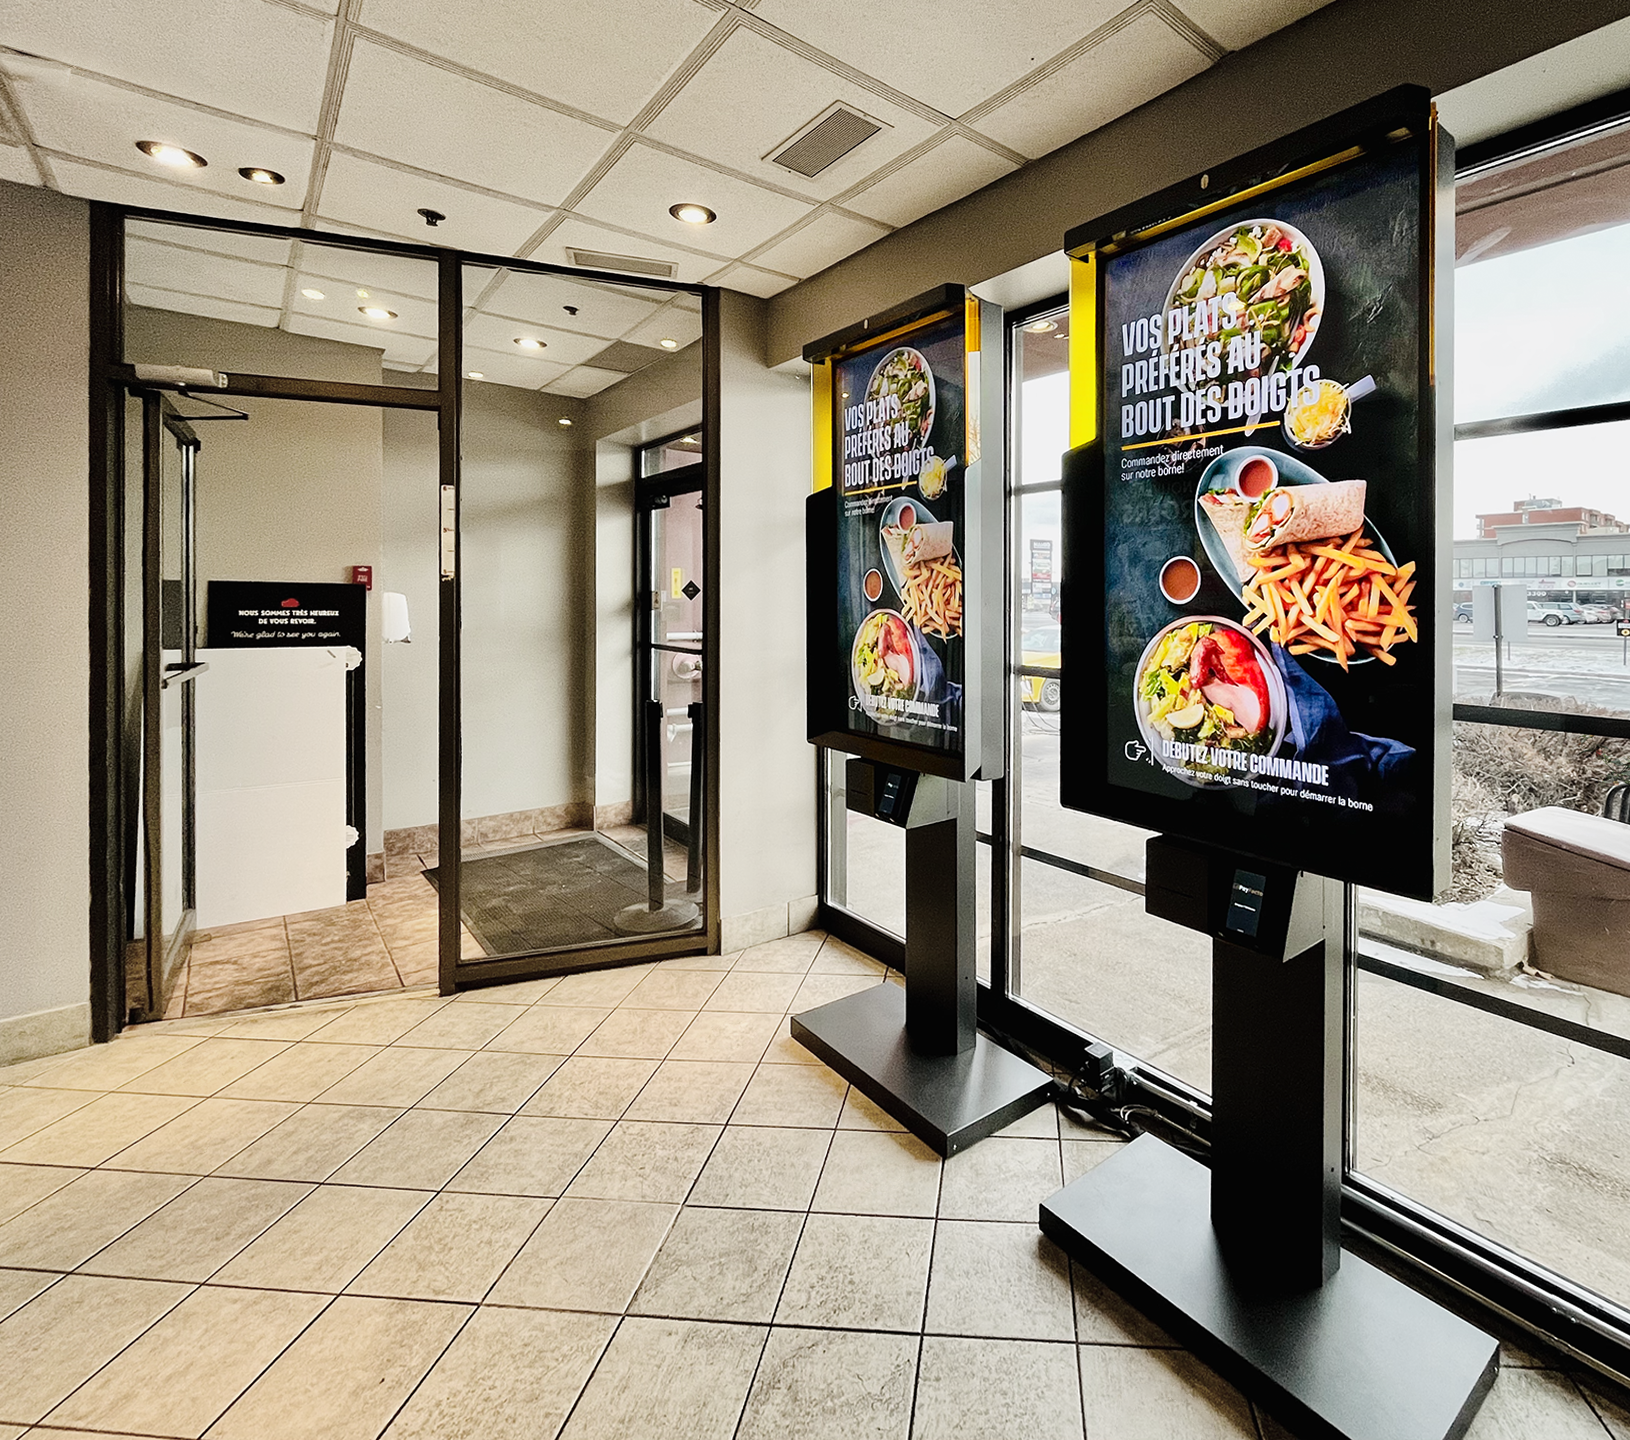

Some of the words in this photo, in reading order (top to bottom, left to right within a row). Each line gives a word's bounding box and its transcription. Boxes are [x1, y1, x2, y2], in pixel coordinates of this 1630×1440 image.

[1121, 314, 1163, 357] VOS
[1167, 291, 1237, 345] PLATS
[1121, 338, 1221, 398] PRÉFÉRÉS
[1227, 330, 1261, 375] AU
[845, 404, 864, 431] VOS
[867, 393, 899, 425] PLATS
[1121, 396, 1175, 439] BOUT
[1180, 384, 1222, 428] DES
[1228, 365, 1321, 420] DOIGTS
[845, 423, 892, 460] PRÉFÉRÉS
[893, 421, 909, 449] AU
[1121, 453, 1170, 469] Commandez
[1171, 444, 1224, 462] directement
[845, 459, 871, 487] BOUT
[872, 453, 892, 483] DES
[894, 446, 935, 479] DOIGTS
[1120, 472, 1134, 481] sur
[1135, 468, 1156, 479] notre
[1157, 463, 1185, 477] borne!
[255, 630, 276, 640] glad
[317, 630, 341, 639] again.
[1162, 737, 1209, 764] DÉBUTEZ
[1210, 746, 1248, 771] VOTRE
[1250, 753, 1330, 787] COMMANDE
[1162, 763, 1195, 776] Approchez
[1196, 770, 1213, 780] votre
[1214, 772, 1231, 786] doigt
[1232, 778, 1249, 788] sans
[1250, 780, 1279, 793] toucher
[1280, 786, 1298, 797] pour
[1299, 789, 1336, 804] démarrer
[1338, 796, 1346, 806] la
[1347, 798, 1374, 812] borne
